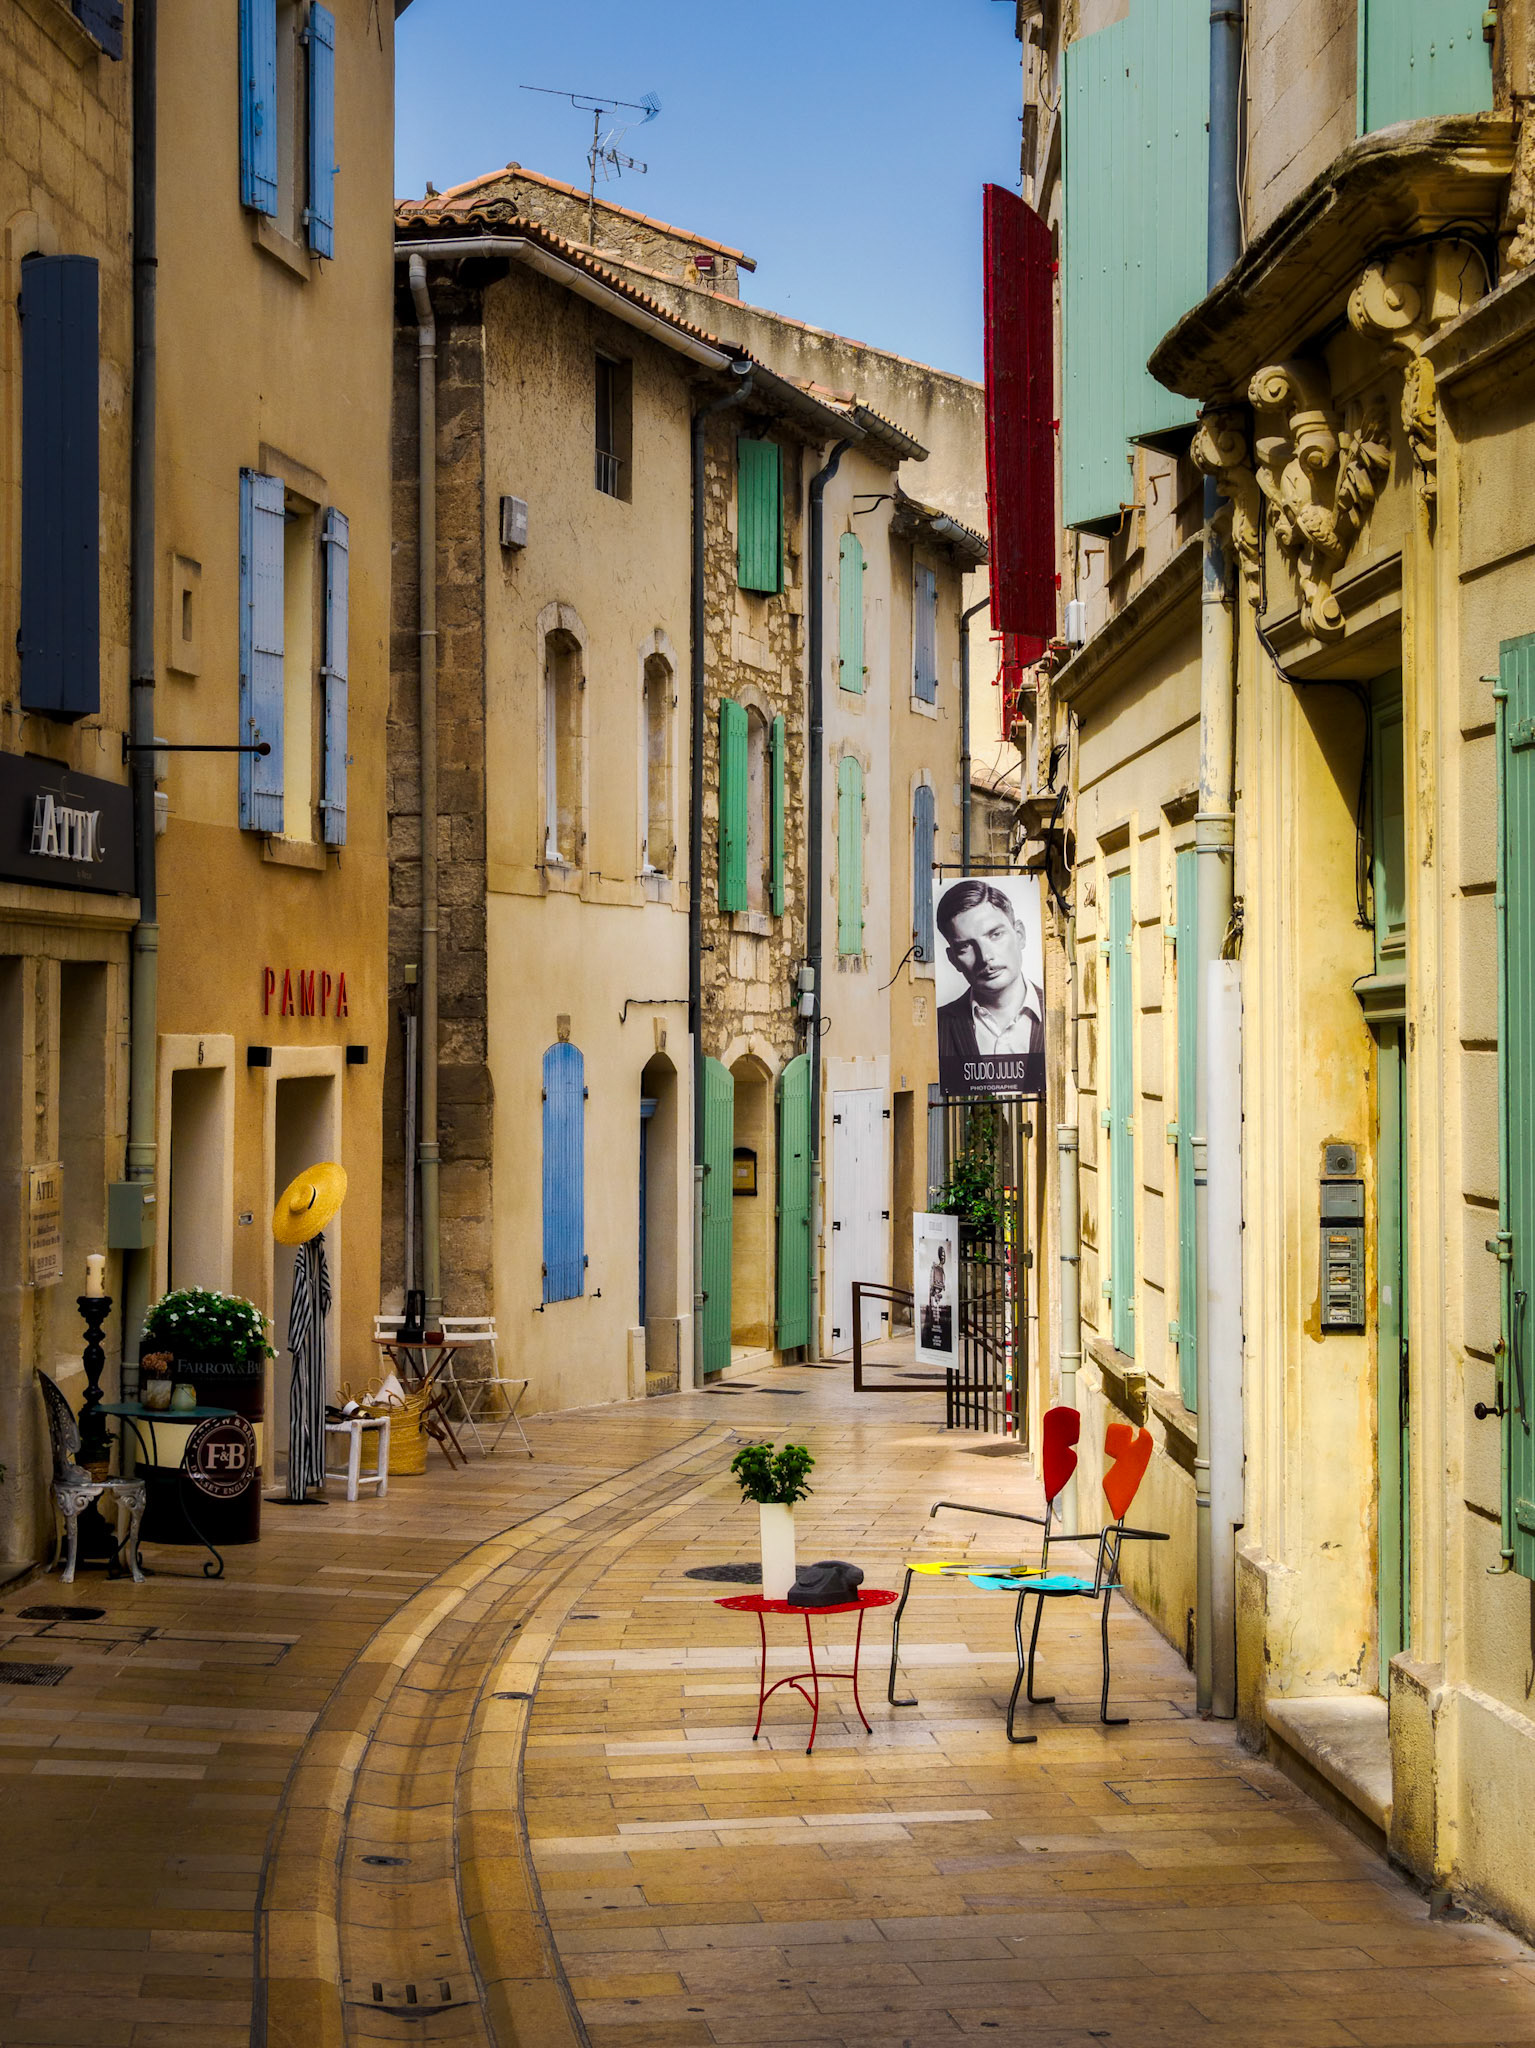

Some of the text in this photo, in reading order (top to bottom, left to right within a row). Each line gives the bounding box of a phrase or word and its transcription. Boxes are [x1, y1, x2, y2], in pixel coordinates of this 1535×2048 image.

[263, 966, 349, 1018] PAMPA
[963, 1061, 1025, 1080] STUDIO JULIUS
[177, 1359, 235, 1375] FARROW
[205, 1443, 246, 1470] F&B
